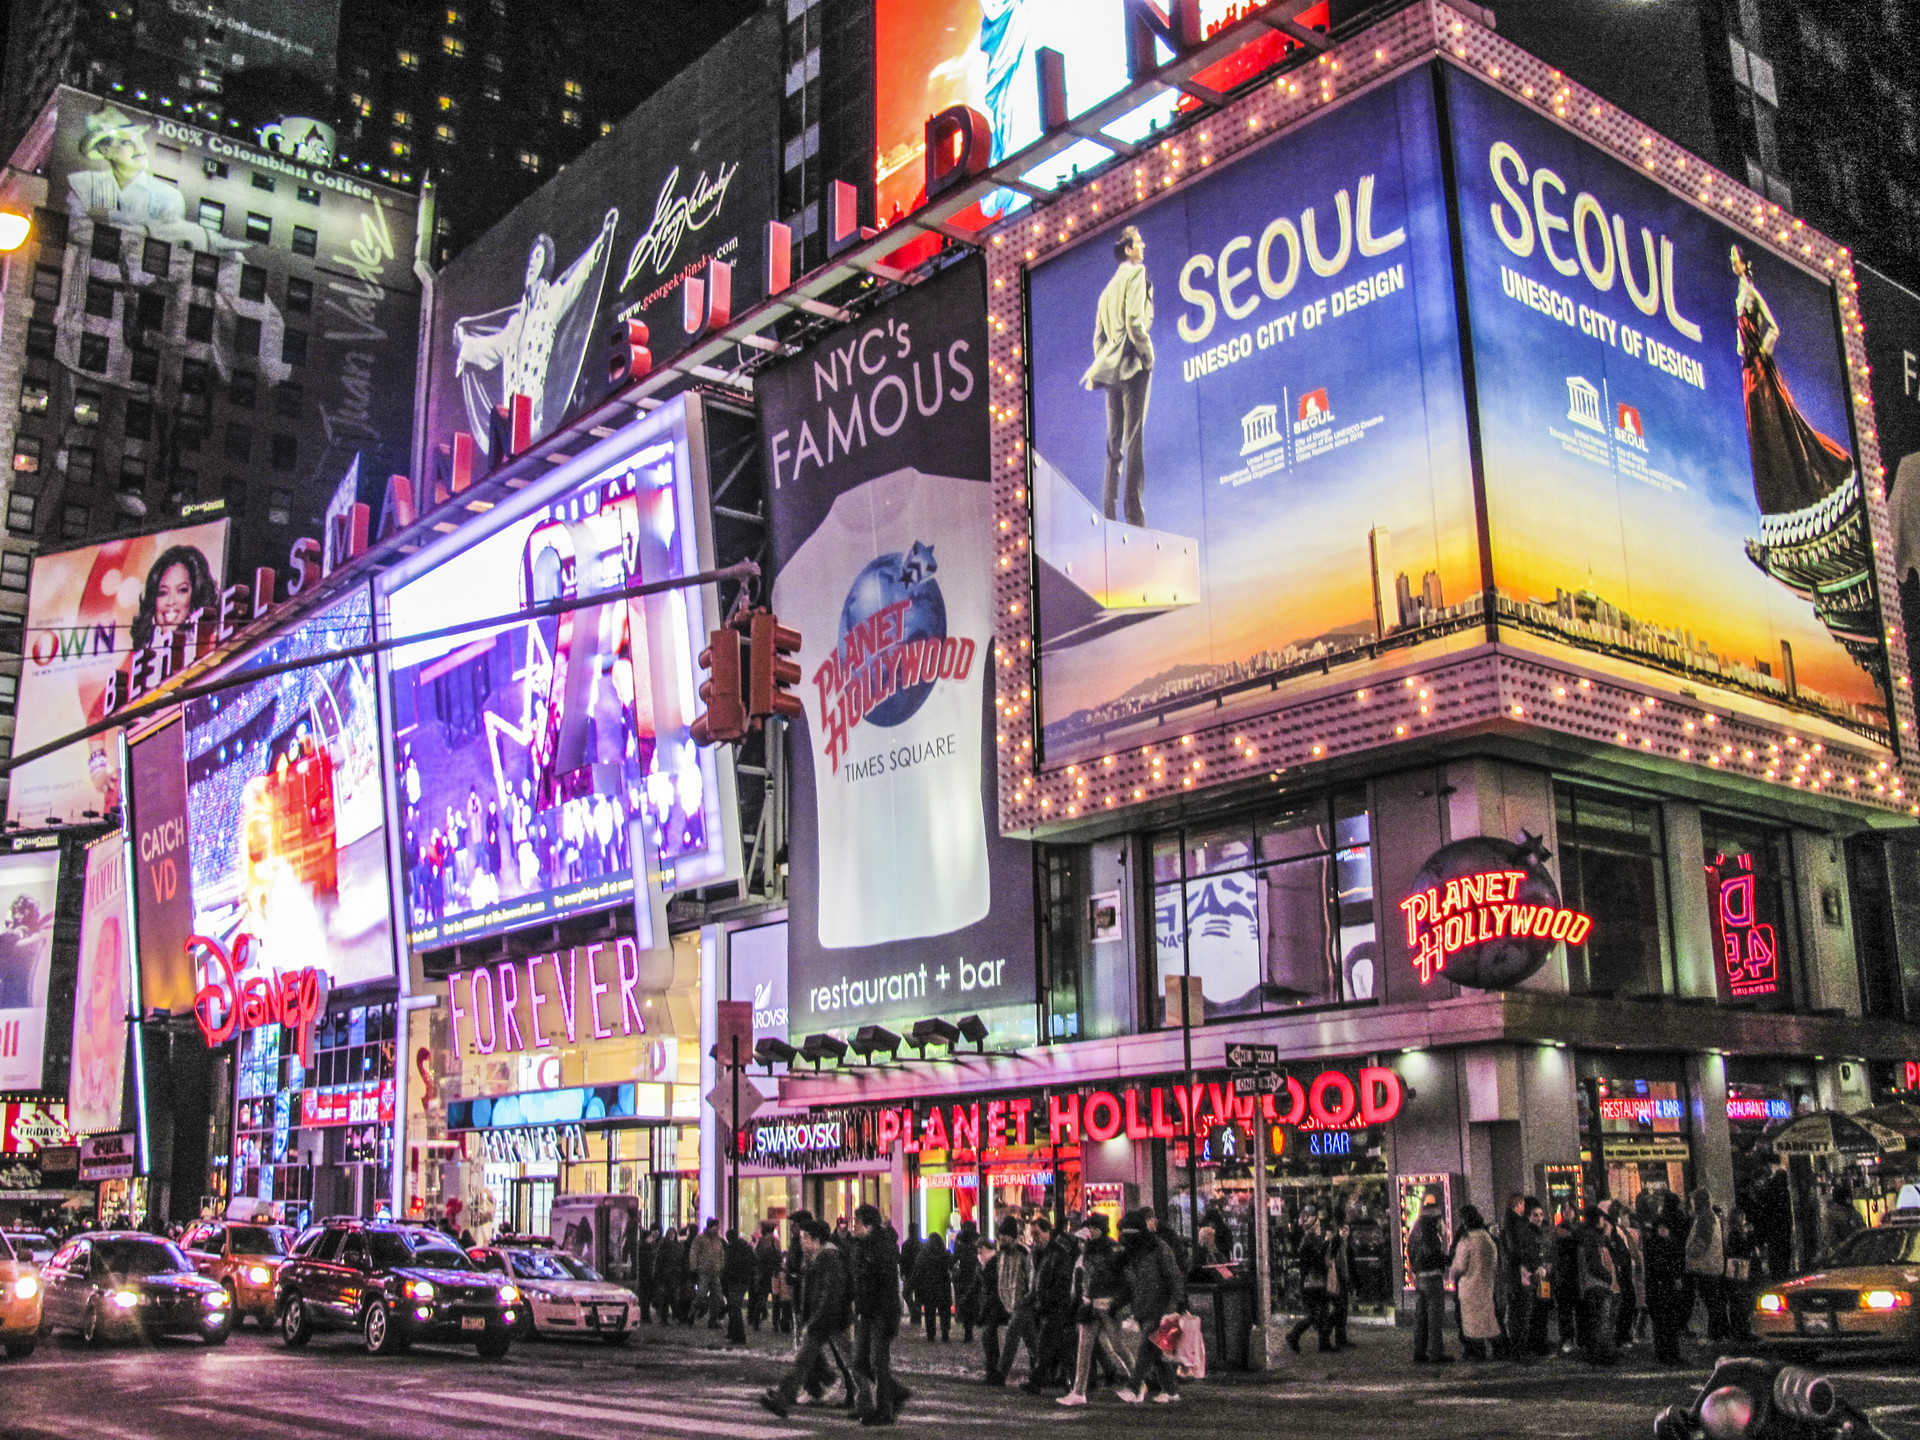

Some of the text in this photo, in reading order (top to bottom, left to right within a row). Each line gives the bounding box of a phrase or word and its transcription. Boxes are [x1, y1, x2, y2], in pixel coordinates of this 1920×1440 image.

[157, 121, 203, 147] 100%
[208, 136, 308, 179] Colombian
[324, 195, 394, 339] Valdez
[1177, 174, 1406, 343] SEOUL
[1489, 141, 1703, 343] SEOUL
[1183, 264, 1405, 383] UNESCO CITY OF DESIGN
[1501, 265, 1706, 390] UNESCO CITY OF DESIGN
[813, 319, 912, 402] NYC's
[771, 340, 975, 489] FAMOUS
[1293, 410, 1335, 434] SEOUL
[1614, 426, 1649, 453] SEOUL
[33, 620, 116, 666] OWN
[812, 599, 913, 735] PLANET
[825, 636, 977, 776] HOLLYWOOD
[845, 734, 956, 785] TIMES SQUARE
[141, 816, 185, 862] CATCH
[151, 859, 177, 903] VD
[1400, 869, 1528, 948] PLANET
[1415, 906, 1594, 984] HOLLYWOOD
[448, 936, 645, 1059] FOREVER
[810, 966, 929, 1013] restaurant
[960, 956, 1005, 987] bar
[350, 1097, 379, 1121] RIDE
[755, 1122, 841, 1153] SWAROVSKI
[877, 1066, 1401, 1155] PLANET HOLLYWOOD
[1602, 1100, 1681, 1119] RESTAURANT & BAR
[1771, 1100, 1787, 1118] BAR
[483, 1124, 586, 1163] FOREVER 21
[1309, 1132, 1351, 1155] & BAR
[916, 1175, 958, 1189] RSTAURANT
[1038, 1172, 1054, 1184] BAR
